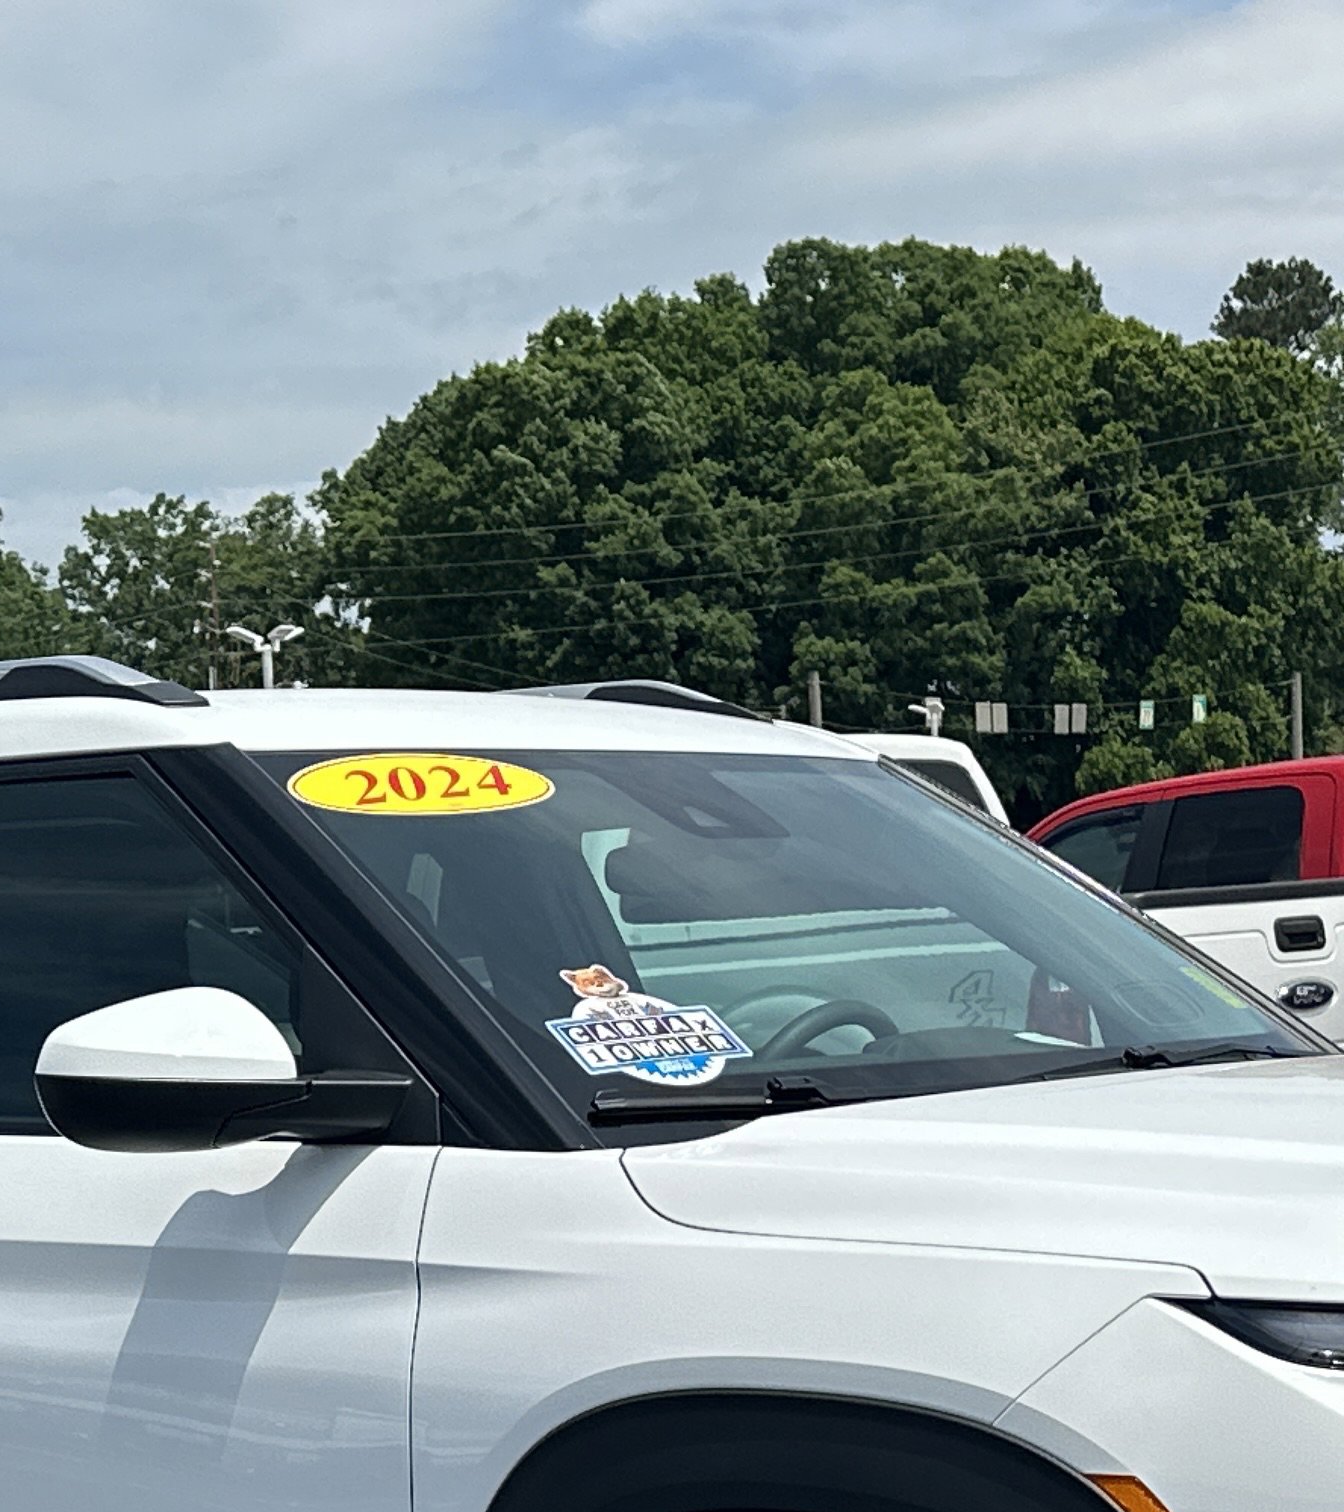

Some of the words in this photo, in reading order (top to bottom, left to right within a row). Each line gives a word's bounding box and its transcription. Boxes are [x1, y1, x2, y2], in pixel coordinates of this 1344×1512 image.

[344, 763, 513, 806] 2024
[567, 1014, 716, 1043] CARFAX
[586, 1048, 607, 1064] 1
[611, 1033, 733, 1062] OWNER
